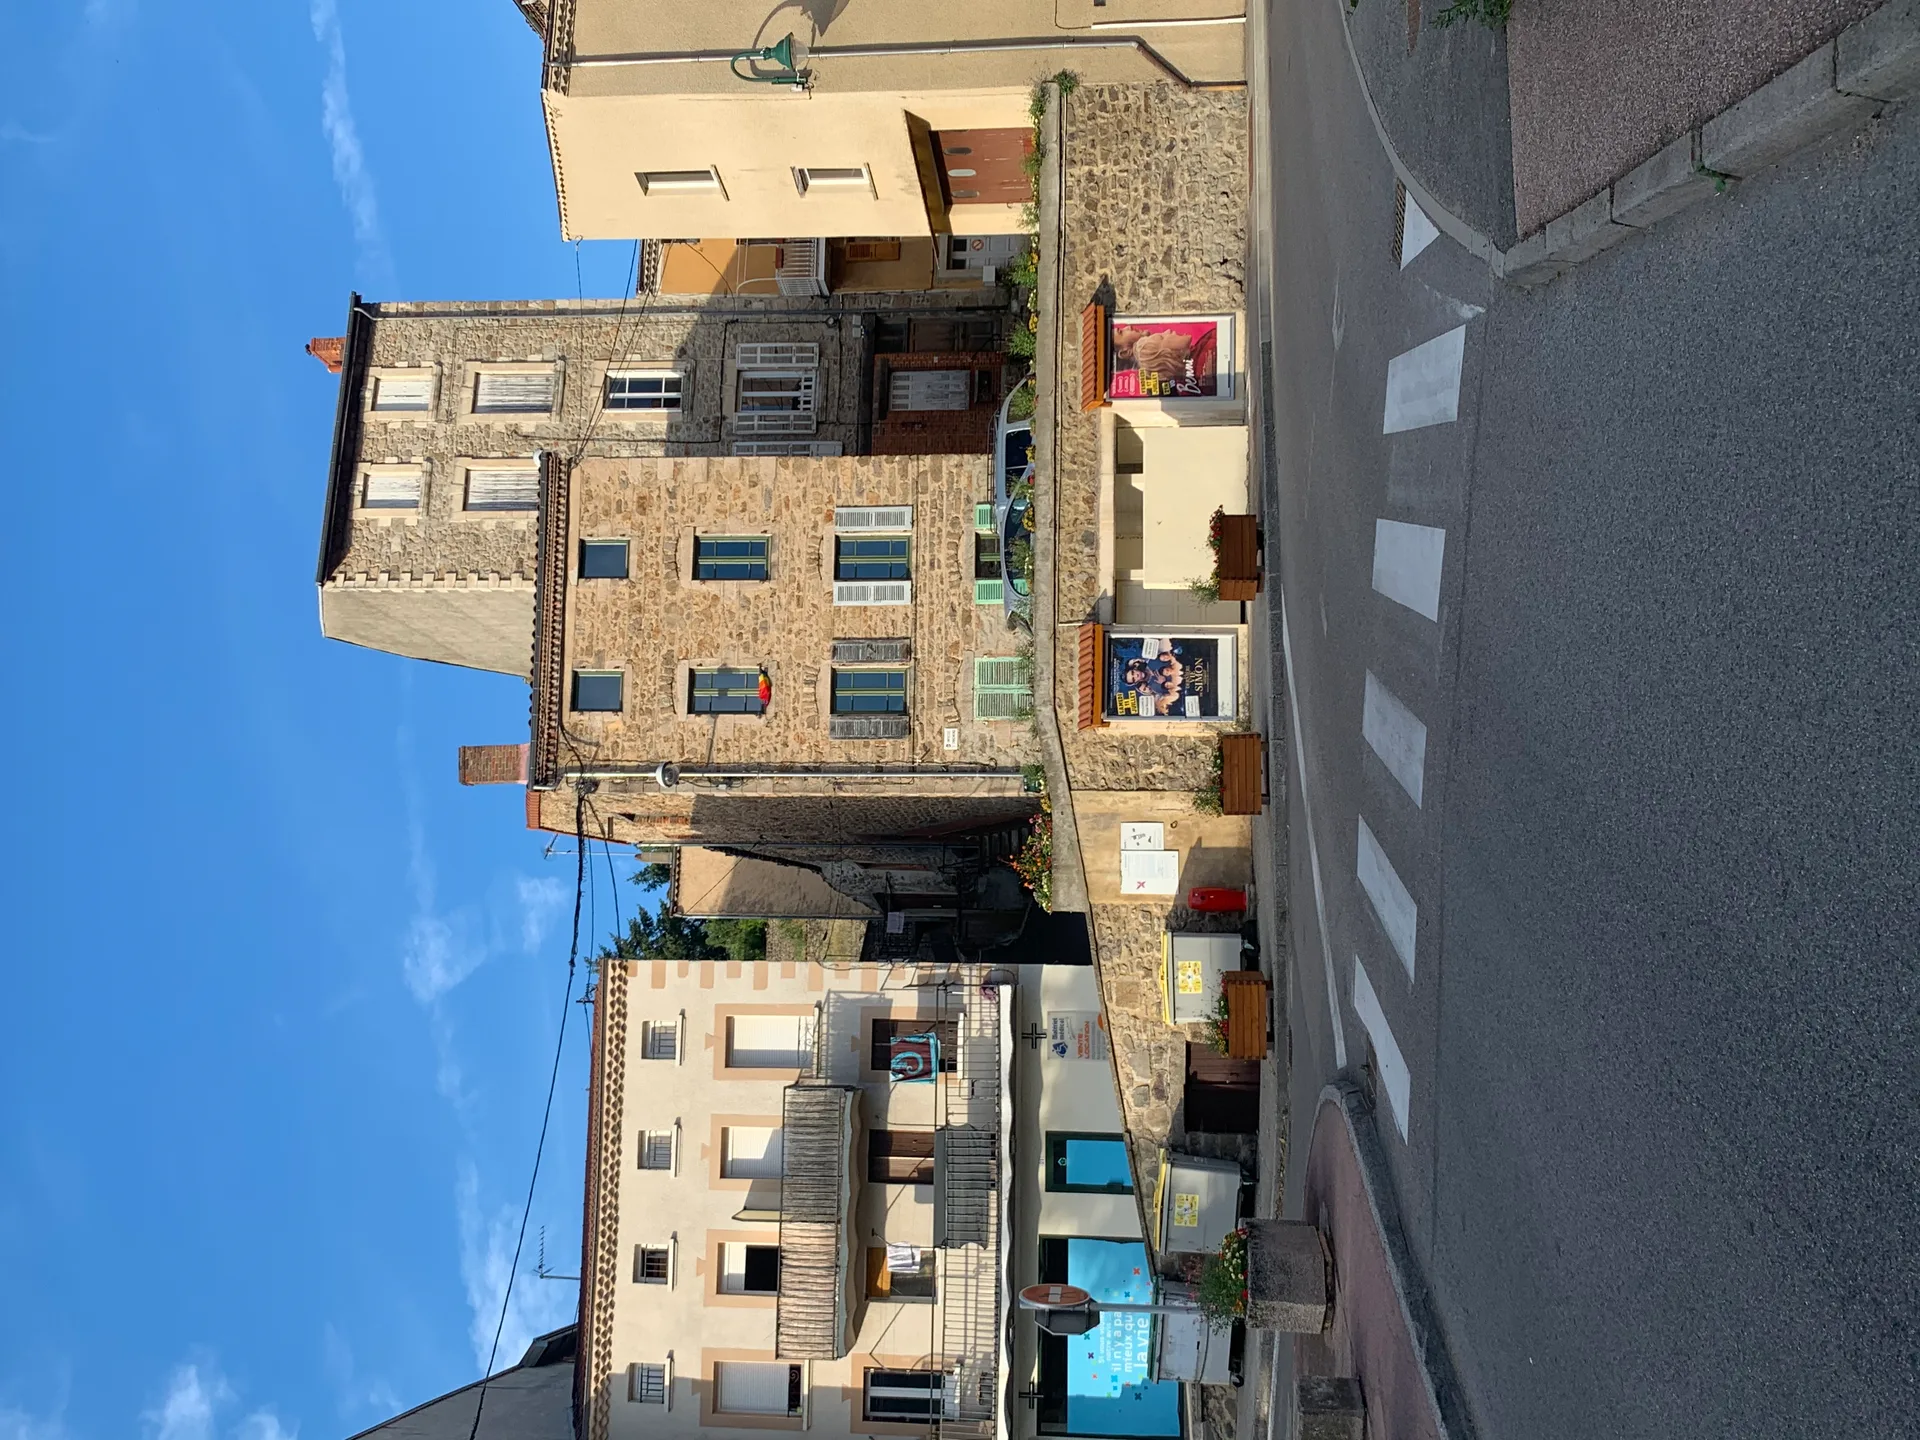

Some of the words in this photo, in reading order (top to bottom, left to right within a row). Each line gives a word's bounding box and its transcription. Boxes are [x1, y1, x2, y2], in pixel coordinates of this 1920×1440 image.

[1177, 358, 1201, 393] Benni
[1194, 658, 1203, 692] SIMON
[1114, 1311, 1124, 1326] pa
[1124, 1312, 1135, 1331] qu
[1133, 1318, 1149, 1347] vie
[1112, 1341, 1124, 1359] n'y
[1123, 1335, 1132, 1372] mieux
[1112, 1364, 1122, 1372] il
[1133, 1352, 1148, 1368] la
